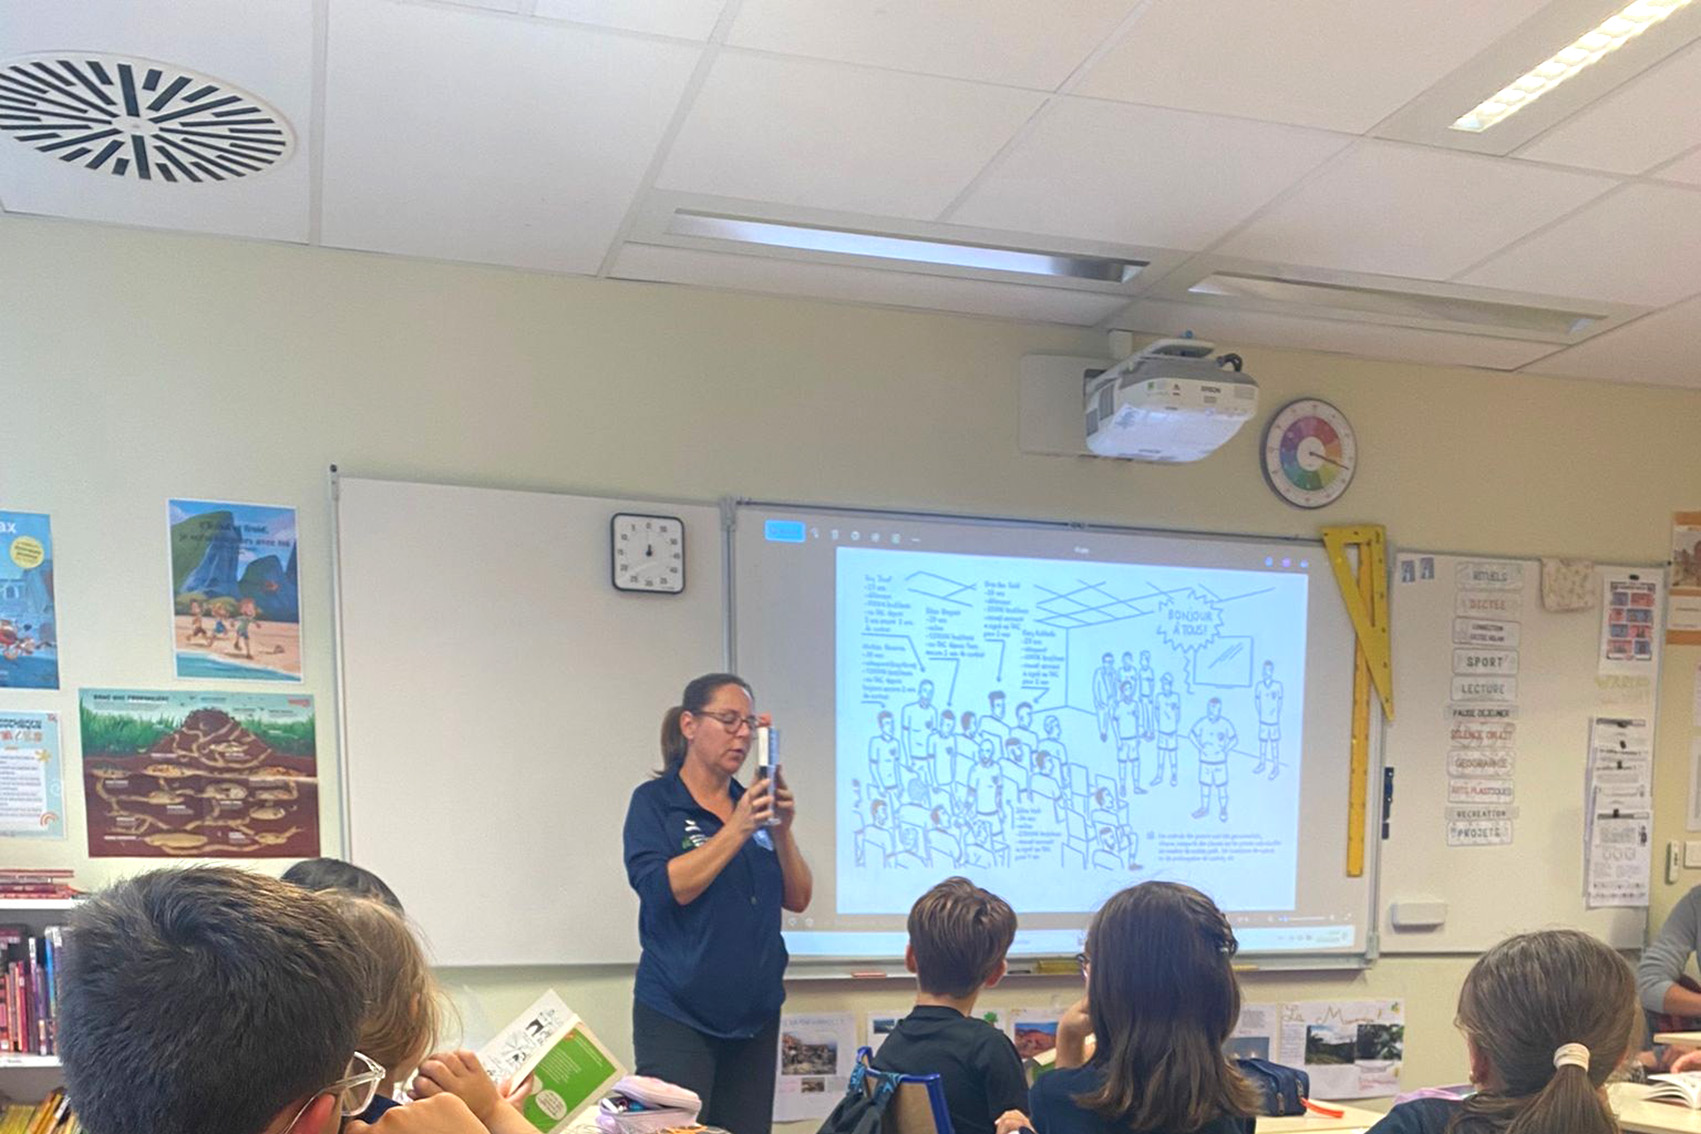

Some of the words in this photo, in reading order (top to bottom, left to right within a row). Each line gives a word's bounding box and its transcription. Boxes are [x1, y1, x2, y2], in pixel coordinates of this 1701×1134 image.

[1168, 608, 1213, 622] BONJOUR
[1466, 656, 1503, 667] SPORT
[1461, 684, 1506, 694] LECTURE
[1457, 827, 1501, 838] PROJETS
